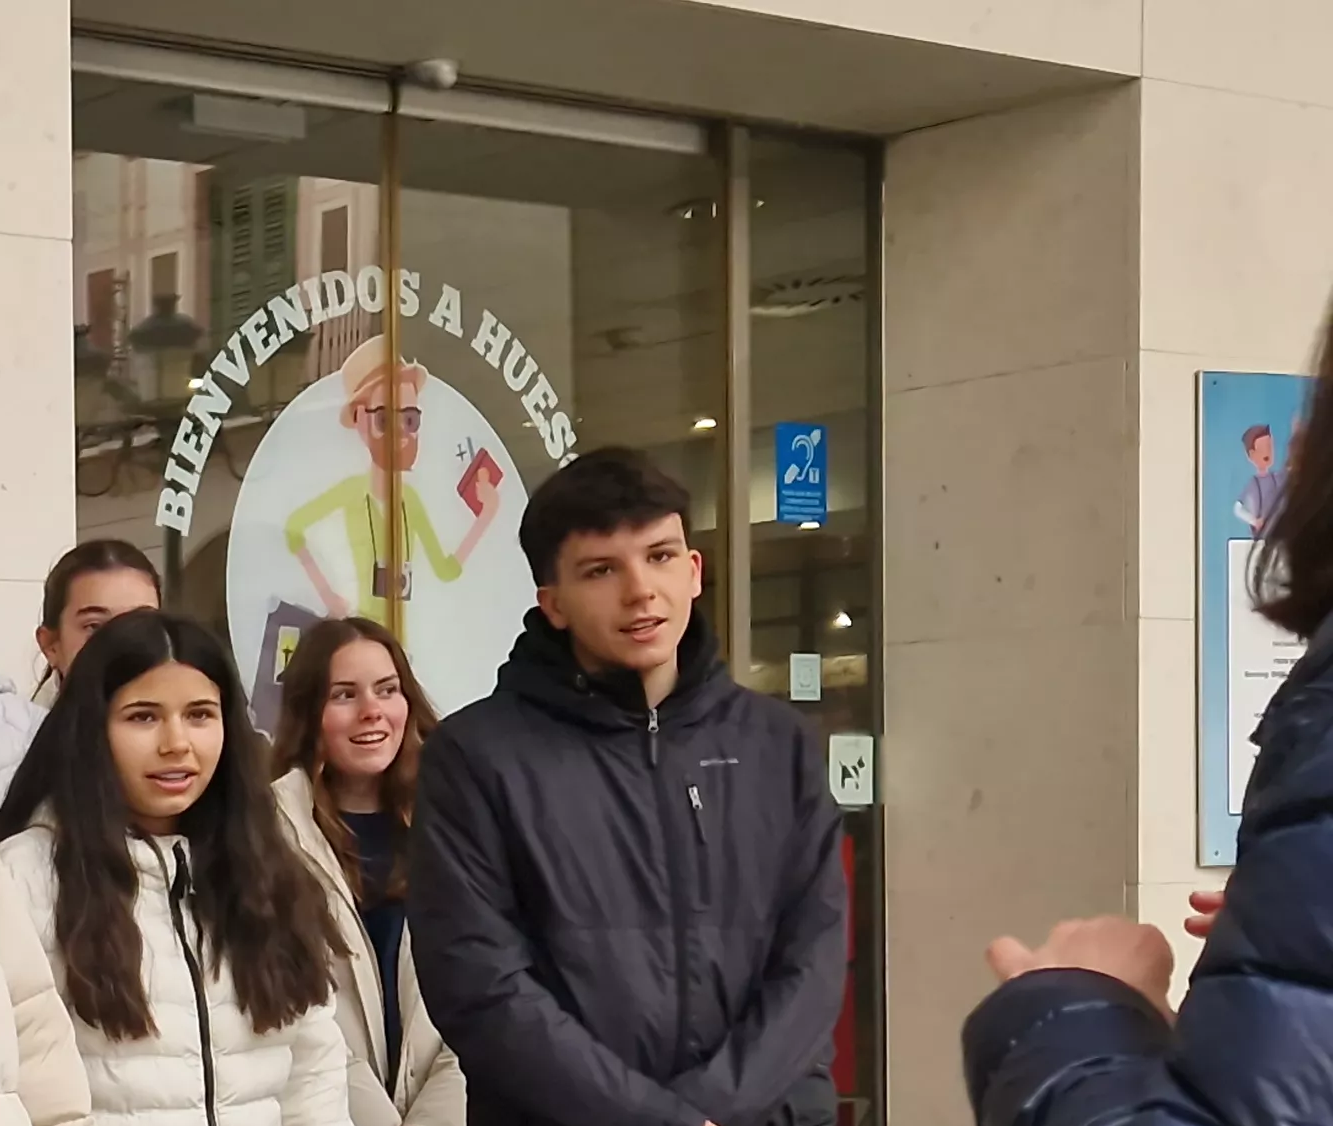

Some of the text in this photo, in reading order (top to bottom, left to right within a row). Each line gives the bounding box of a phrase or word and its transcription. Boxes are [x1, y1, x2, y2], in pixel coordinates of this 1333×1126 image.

[156, 265, 579, 537] BIENVENIDOS A HUES
